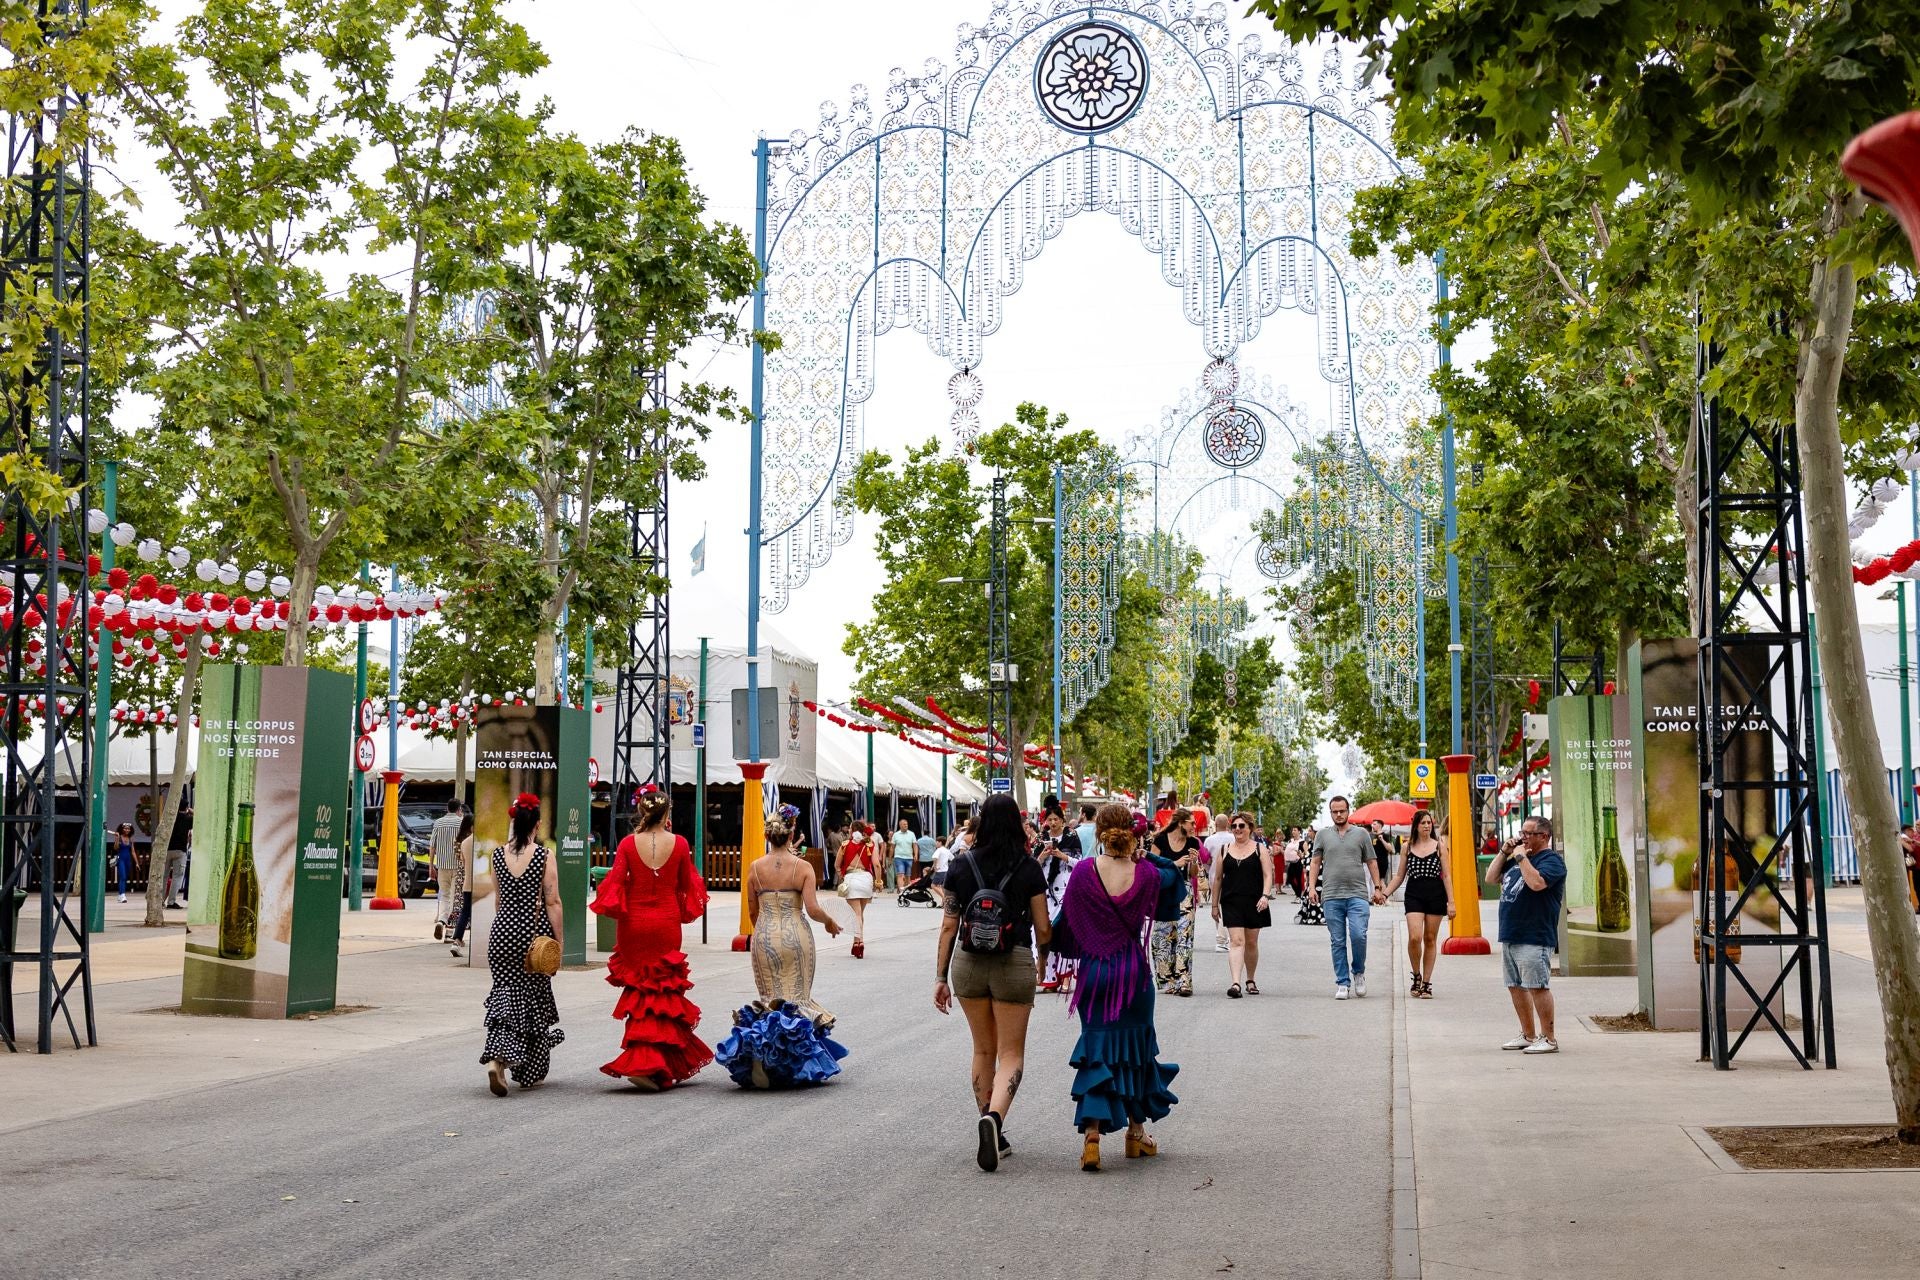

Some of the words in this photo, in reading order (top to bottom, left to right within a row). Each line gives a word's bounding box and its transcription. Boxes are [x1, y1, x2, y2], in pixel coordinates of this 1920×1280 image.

[1653, 706, 1683, 717] TAN
[1687, 704, 1762, 717] EPECIL
[205, 720, 222, 729] EN
[226, 720, 241, 730] EL
[245, 720, 295, 731] CORPUS
[1646, 721, 1691, 732] COMO
[203, 734, 229, 743] NOS
[233, 734, 296, 744] VESTIMOS
[1566, 740, 1581, 749] EN
[1585, 740, 1598, 748] EL
[1601, 739, 1632, 748] CORP
[218, 748, 234, 757] DE
[239, 748, 280, 758] VERDE
[482, 750, 502, 759] TAN
[504, 751, 553, 759] ESPECIAL
[1566, 751, 1589, 760] NOS
[1592, 750, 1632, 759] VESTIM
[477, 761, 507, 769] COMO
[1580, 762, 1595, 771] DE
[1598, 761, 1633, 770] VERDE
[316, 804, 332, 823] 100
[303, 843, 338, 860] Alhambra
